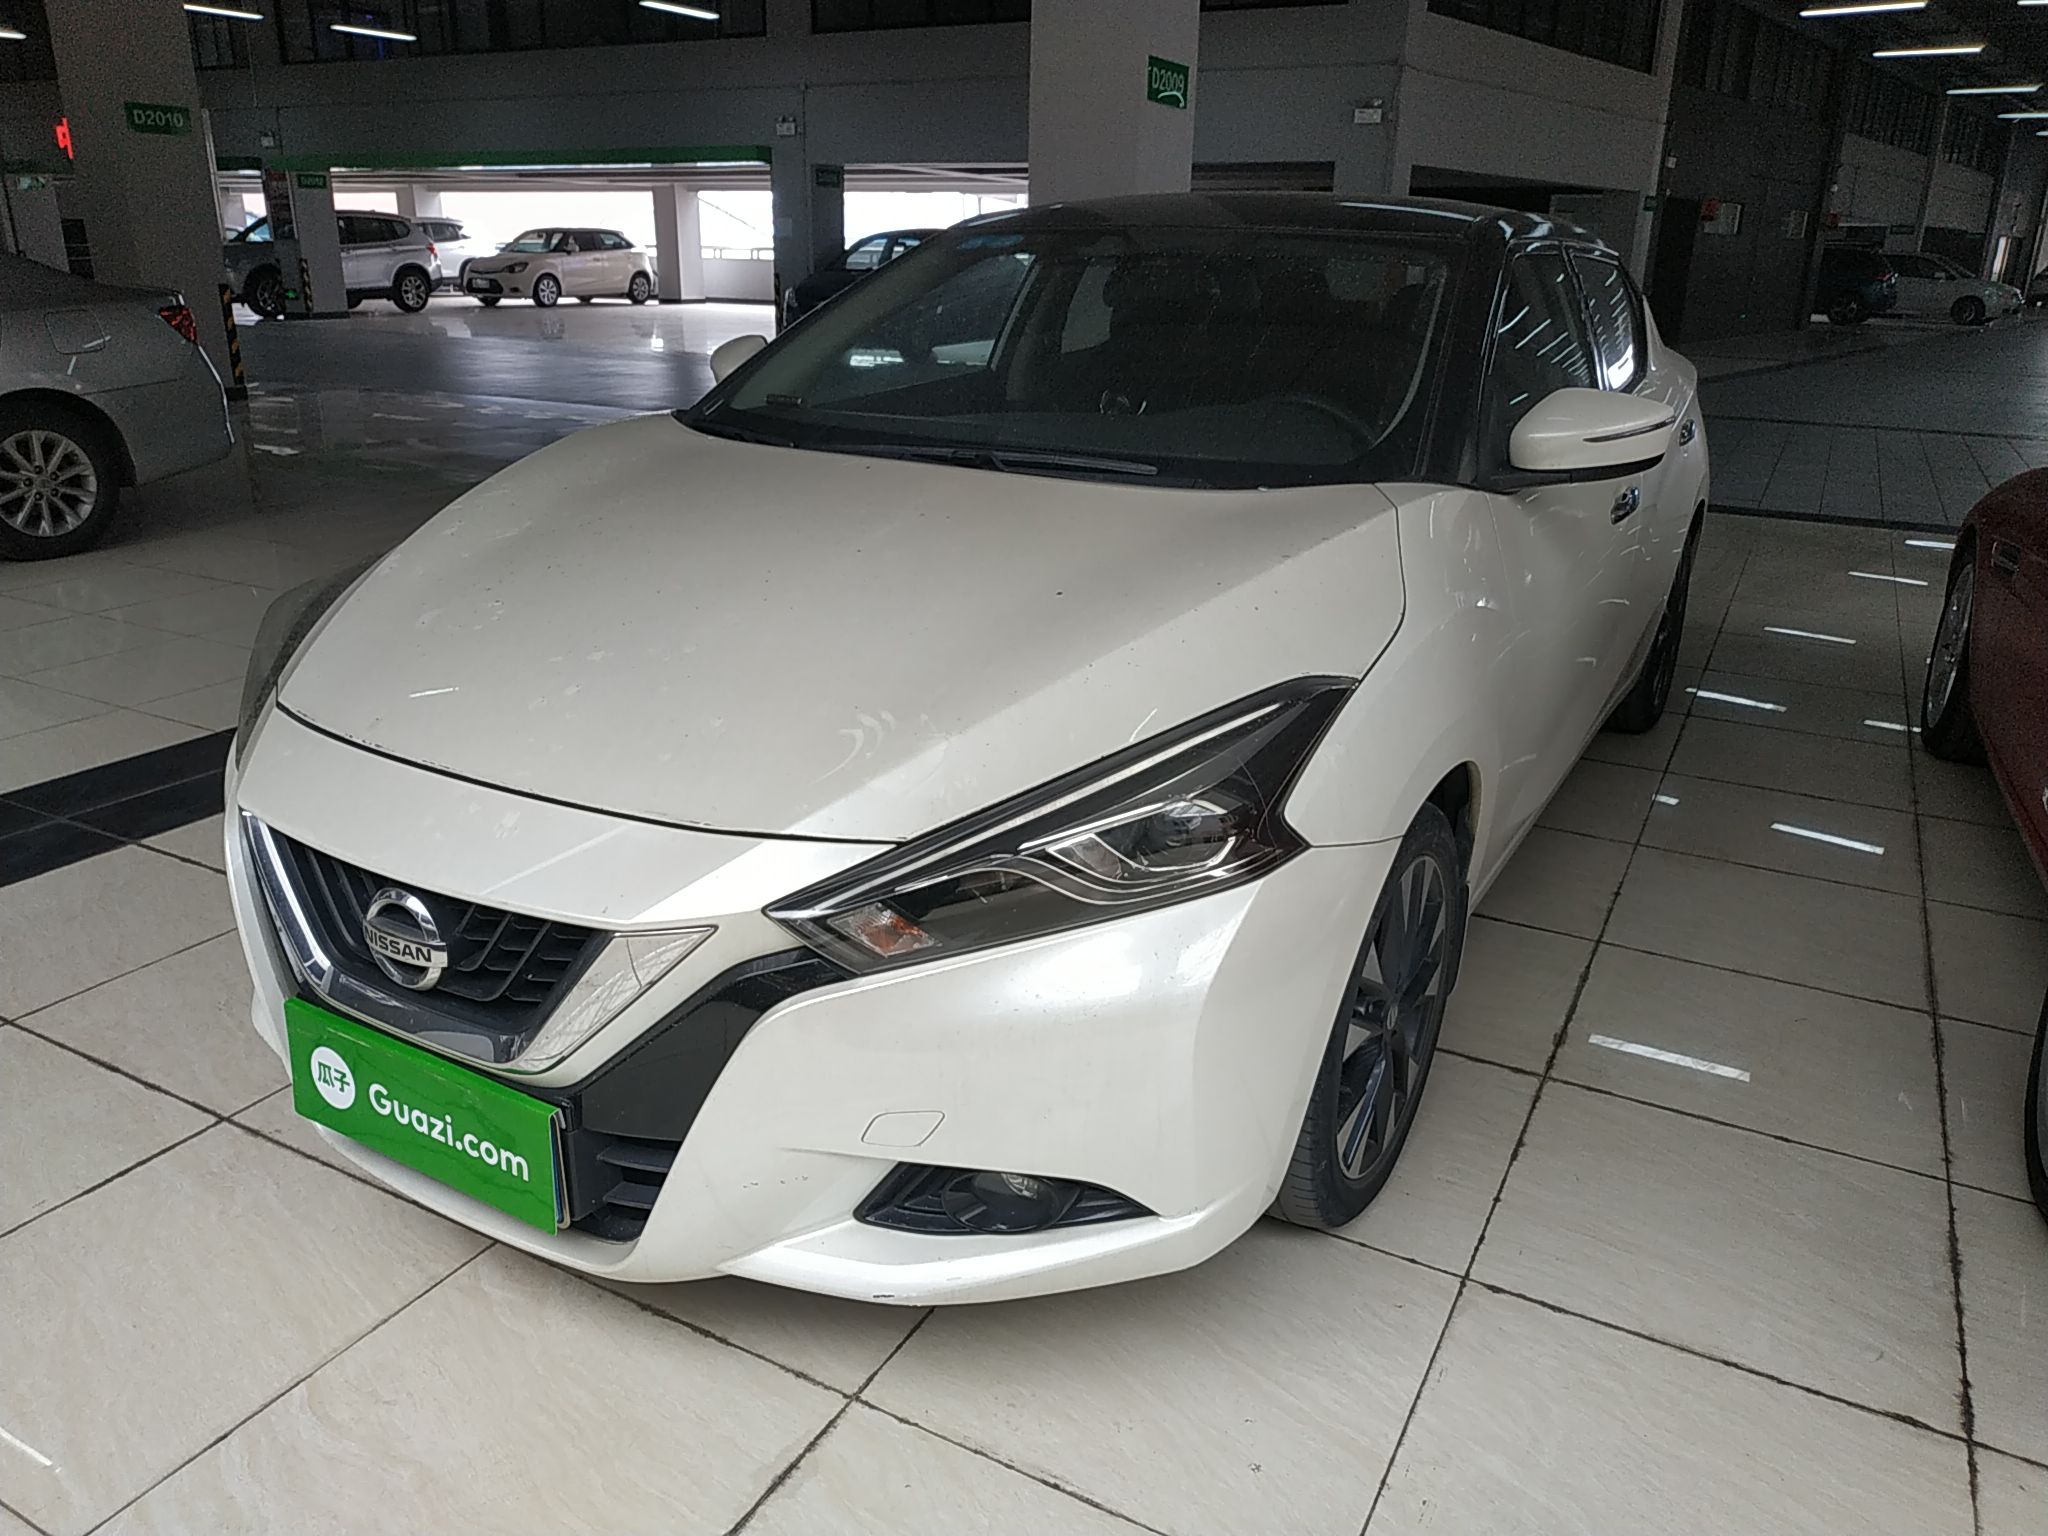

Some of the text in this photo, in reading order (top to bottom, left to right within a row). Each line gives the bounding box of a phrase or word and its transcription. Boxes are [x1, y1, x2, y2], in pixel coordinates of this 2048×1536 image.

[1152, 67, 1184, 93] D2009
[133, 109, 184, 128] D2010
[365, 928, 432, 963] NISSAN
[318, 1061, 351, 1093] 瓜子
[368, 1083, 530, 1182] Guazi.com
